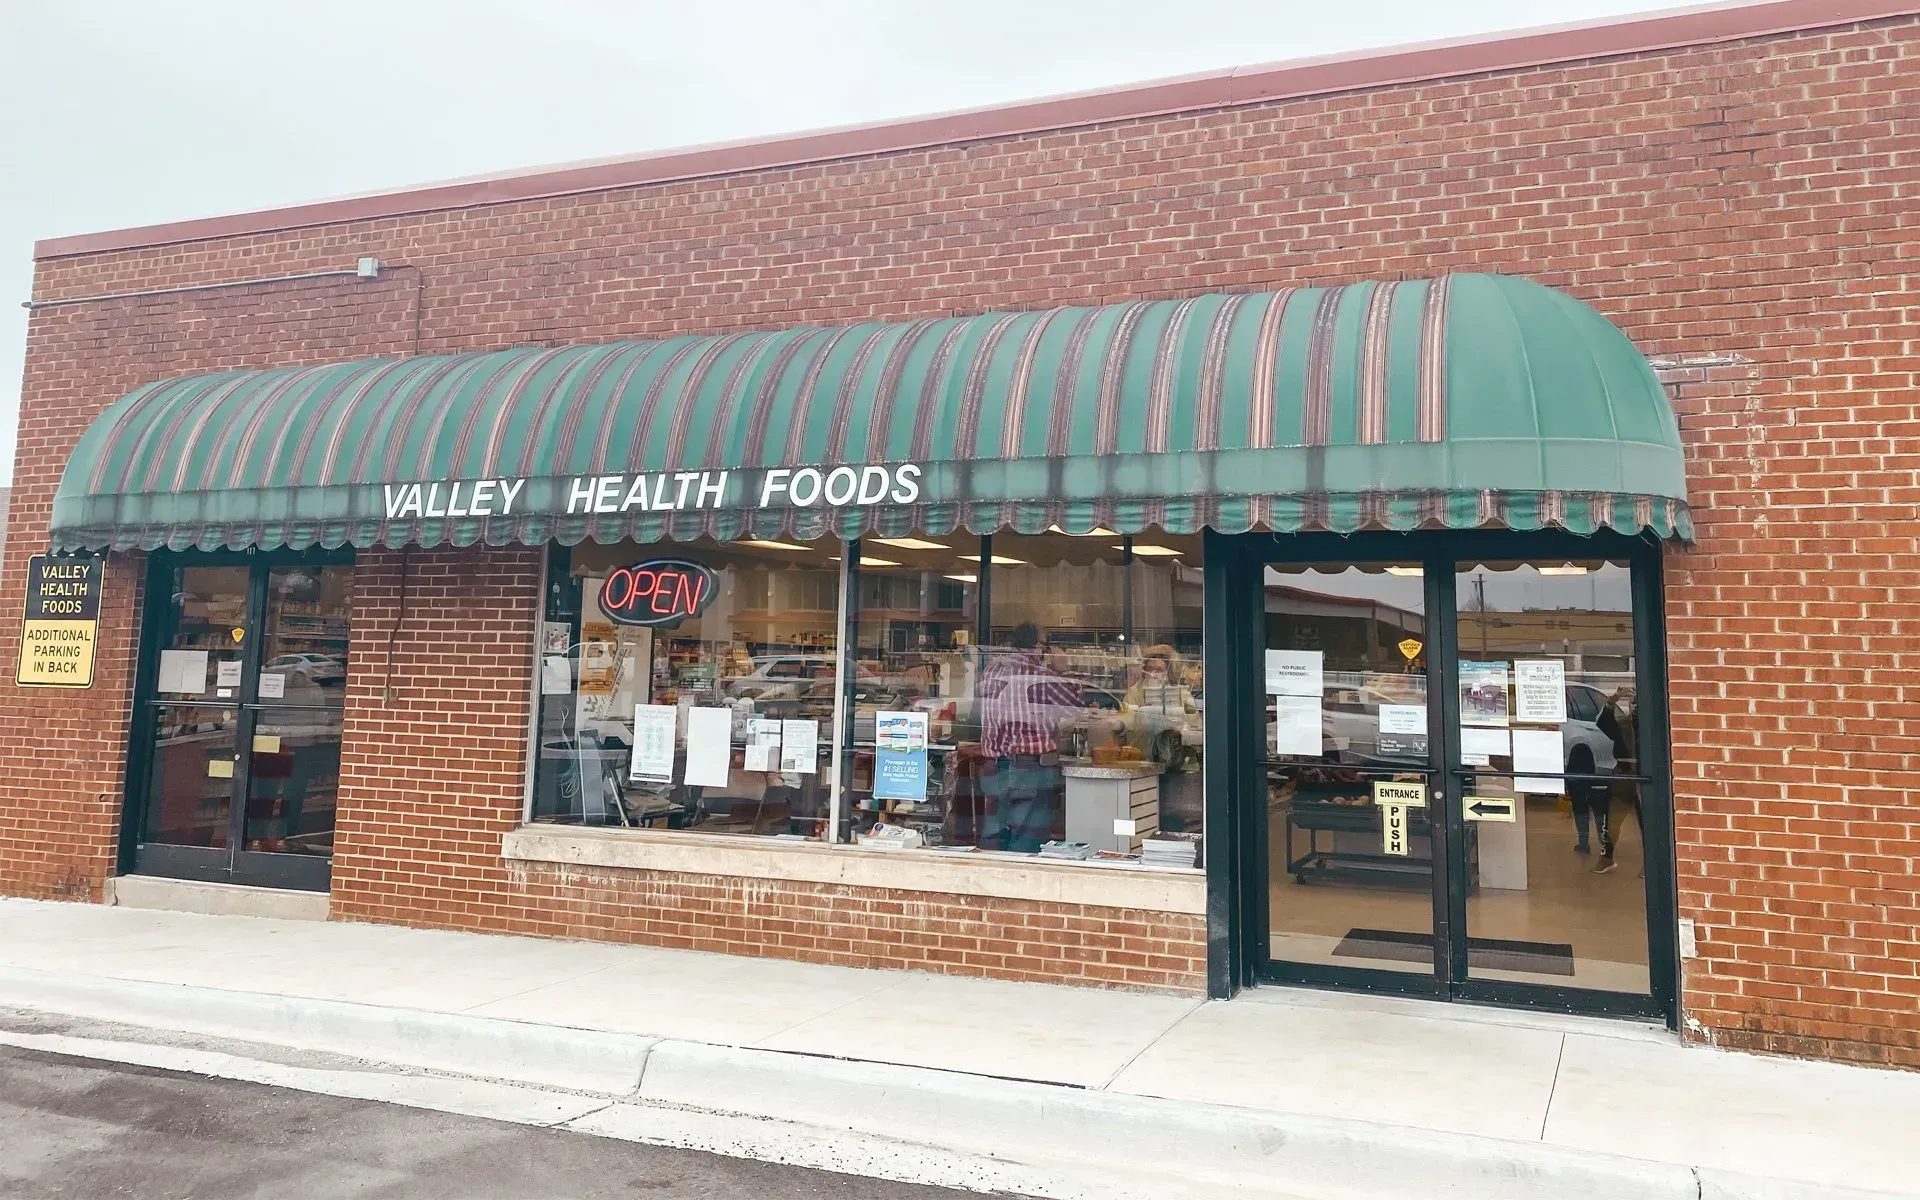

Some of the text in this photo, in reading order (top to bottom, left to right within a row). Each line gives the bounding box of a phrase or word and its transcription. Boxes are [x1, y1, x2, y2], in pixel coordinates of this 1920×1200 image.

[383, 464, 922, 519] VALLEY HEALTH FOODS
[41, 565, 90, 579] VALLEY
[40, 583, 88, 596] HEALTH
[605, 569, 703, 615] OPEN
[41, 600, 82, 613] FOODS
[27, 629, 91, 641] ADDITIONAL
[33, 645, 81, 657] PARKING
[33, 661, 78, 673] IN BACK
[892, 766, 919, 774] SELLING
[1380, 788, 1420, 799] ENTRANCE
[1390, 807, 1401, 851] PUSH
